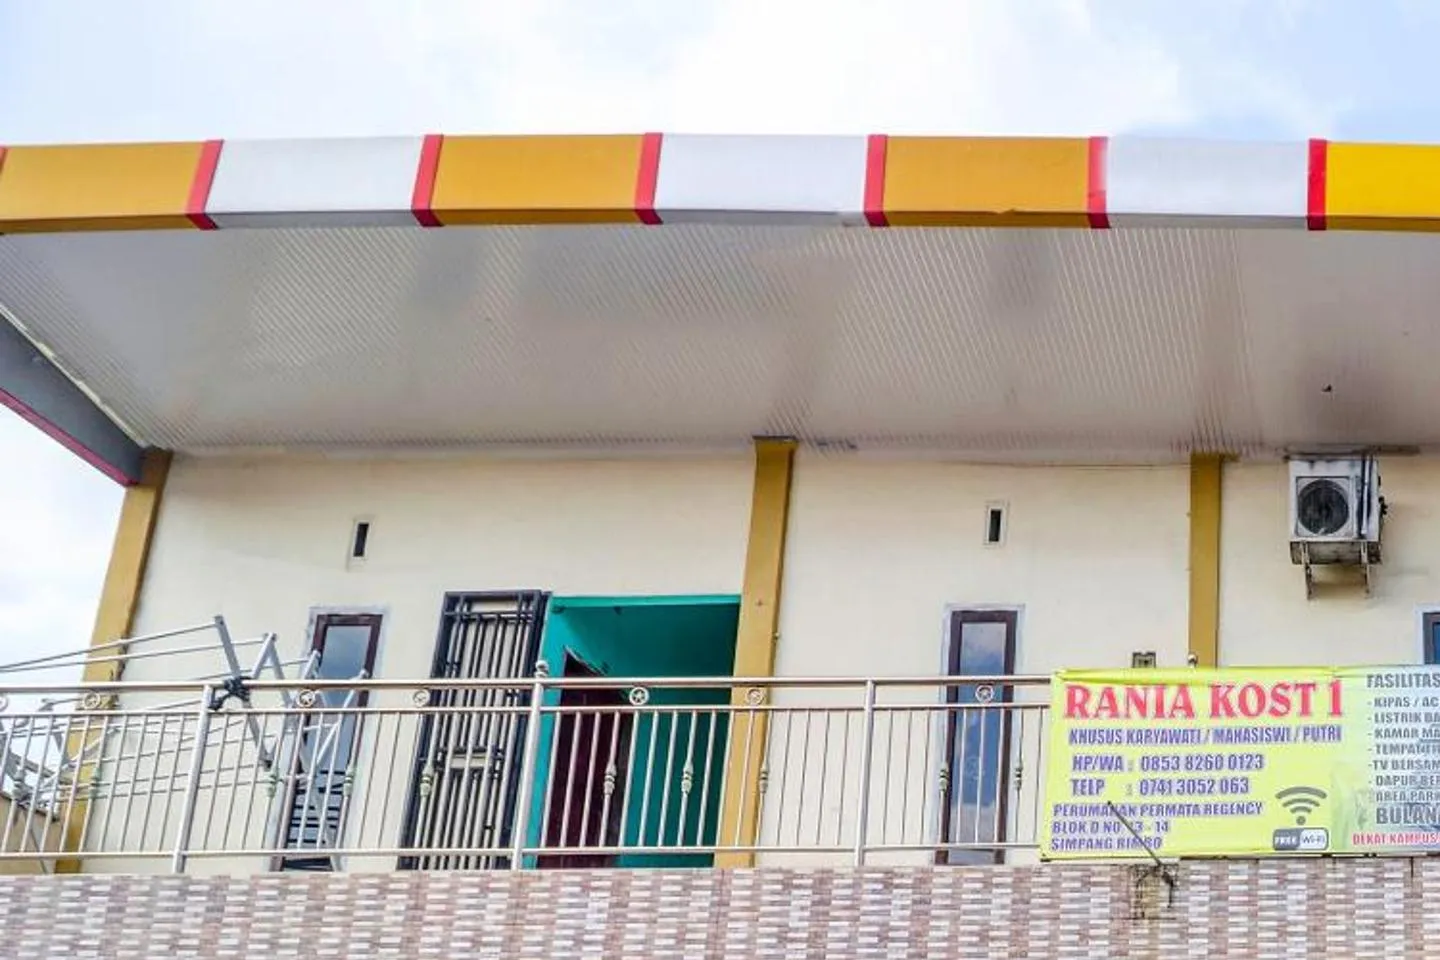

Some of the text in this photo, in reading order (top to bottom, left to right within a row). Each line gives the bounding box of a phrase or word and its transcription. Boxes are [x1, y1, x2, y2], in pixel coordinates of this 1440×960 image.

[1366, 673, 1440, 688] FASILITAS
[1064, 680, 1342, 719] RANIA KOST 1
[1374, 697, 1410, 707] KIPAS
[1422, 697, 1439, 707] AC
[1374, 712, 1421, 723] LISTRIK
[1069, 728, 1122, 745] KHUSUS
[1126, 728, 1200, 745] KARYAWATI
[1212, 727, 1291, 743] MAHASISWI
[1303, 725, 1342, 742] PUTRI
[1374, 728, 1419, 738] KAMAR
[1072, 756, 1124, 771] HP/WA
[1141, 755, 1180, 771] 0853
[1185, 754, 1223, 770] 8260
[1228, 753, 1265, 770] 0123
[1071, 779, 1105, 796] TELP
[1140, 779, 1173, 796] 0741
[1176, 779, 1216, 795] 3052
[1220, 777, 1249, 794] 063
[1376, 775, 1417, 786] DAPUR
[1376, 791, 1406, 802] AREA
[1140, 803, 1200, 817] PERMATA
[1203, 802, 1262, 815] REGENCY
[1053, 821, 1087, 833] BLOK
[1090, 821, 1099, 833] D
[1155, 821, 1169, 832] 14
[1051, 838, 1112, 850] SIMPANG
[1352, 833, 1385, 845] DEKAT
[1389, 832, 1436, 844] KAMPUS
